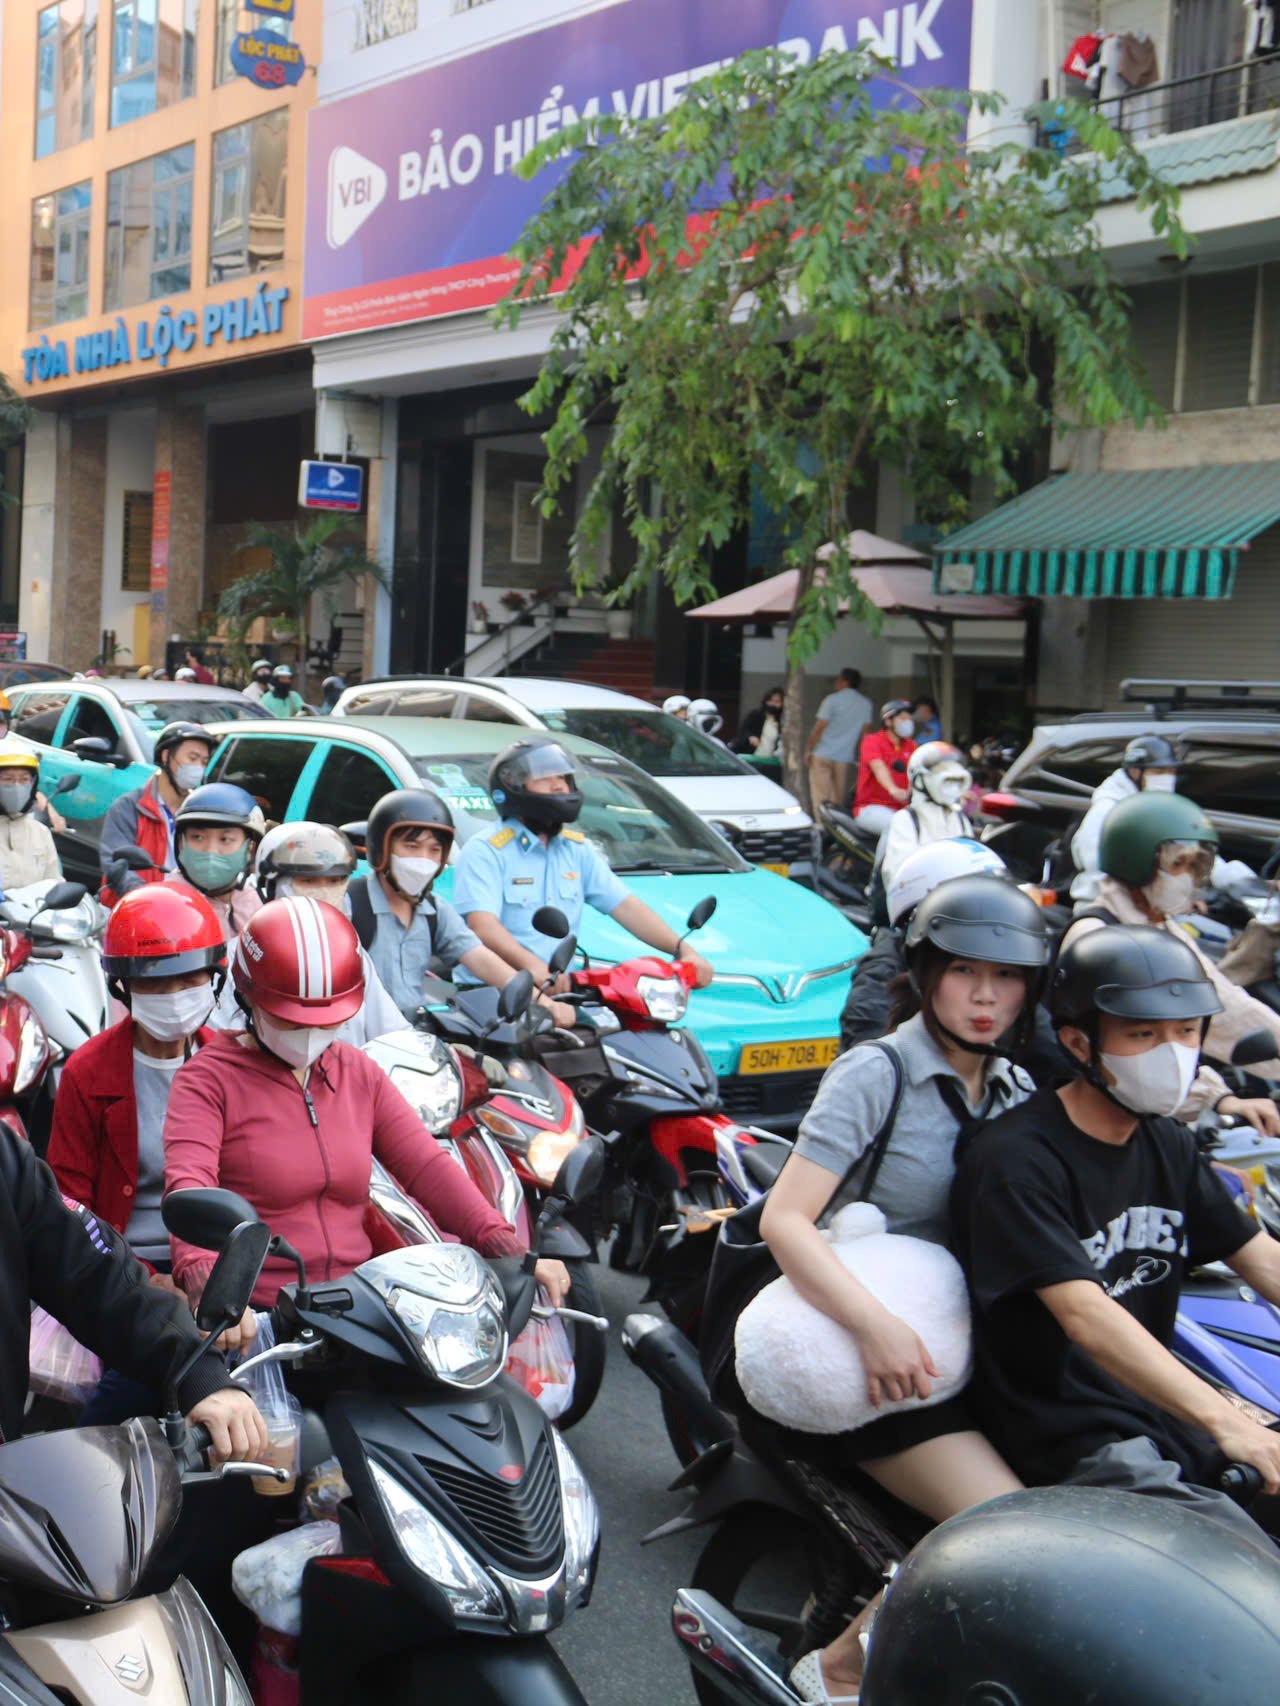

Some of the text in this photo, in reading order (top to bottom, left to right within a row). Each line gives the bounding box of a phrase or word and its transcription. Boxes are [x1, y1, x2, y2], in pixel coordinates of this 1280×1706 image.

[254, 60, 287, 86] 68
[398, 128, 483, 201] BẢO
[338, 176, 372, 208] VBI
[22, 335, 69, 384] TÒA
[74, 317, 132, 373] NHÀ
[136, 305, 198, 367] LỘC
[203, 281, 290, 346] PHÁT
